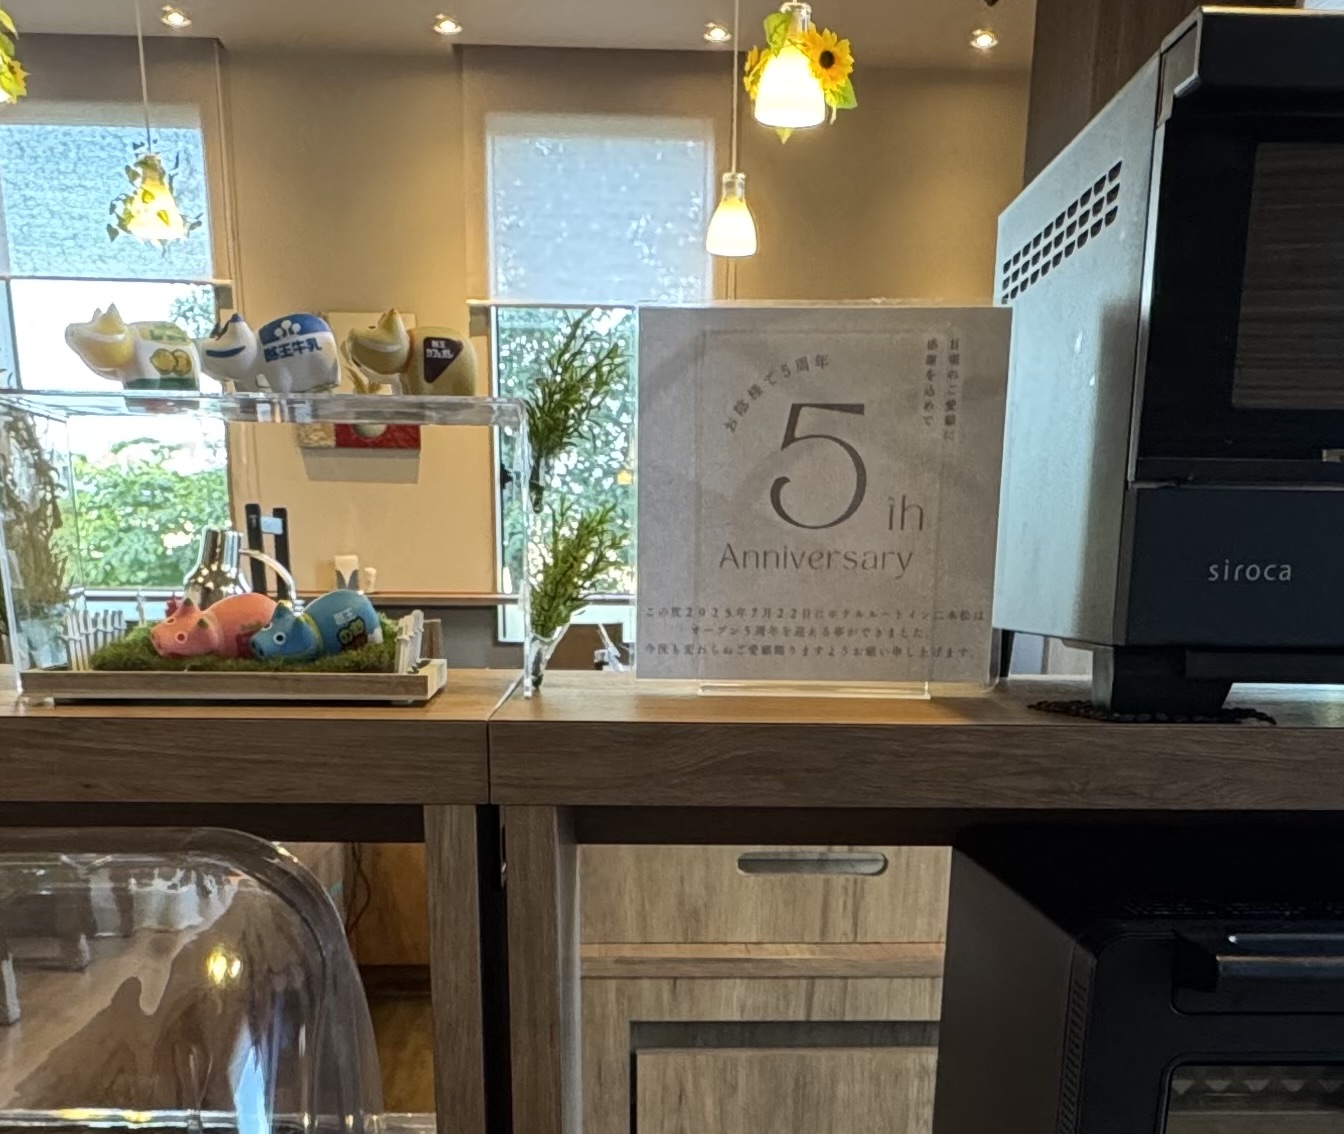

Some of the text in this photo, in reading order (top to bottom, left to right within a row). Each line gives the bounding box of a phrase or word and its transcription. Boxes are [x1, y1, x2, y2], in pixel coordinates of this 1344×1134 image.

[770, 403, 867, 529] 5
[719, 542, 914, 579] Anniversary
[1208, 559, 1292, 581] siroca
